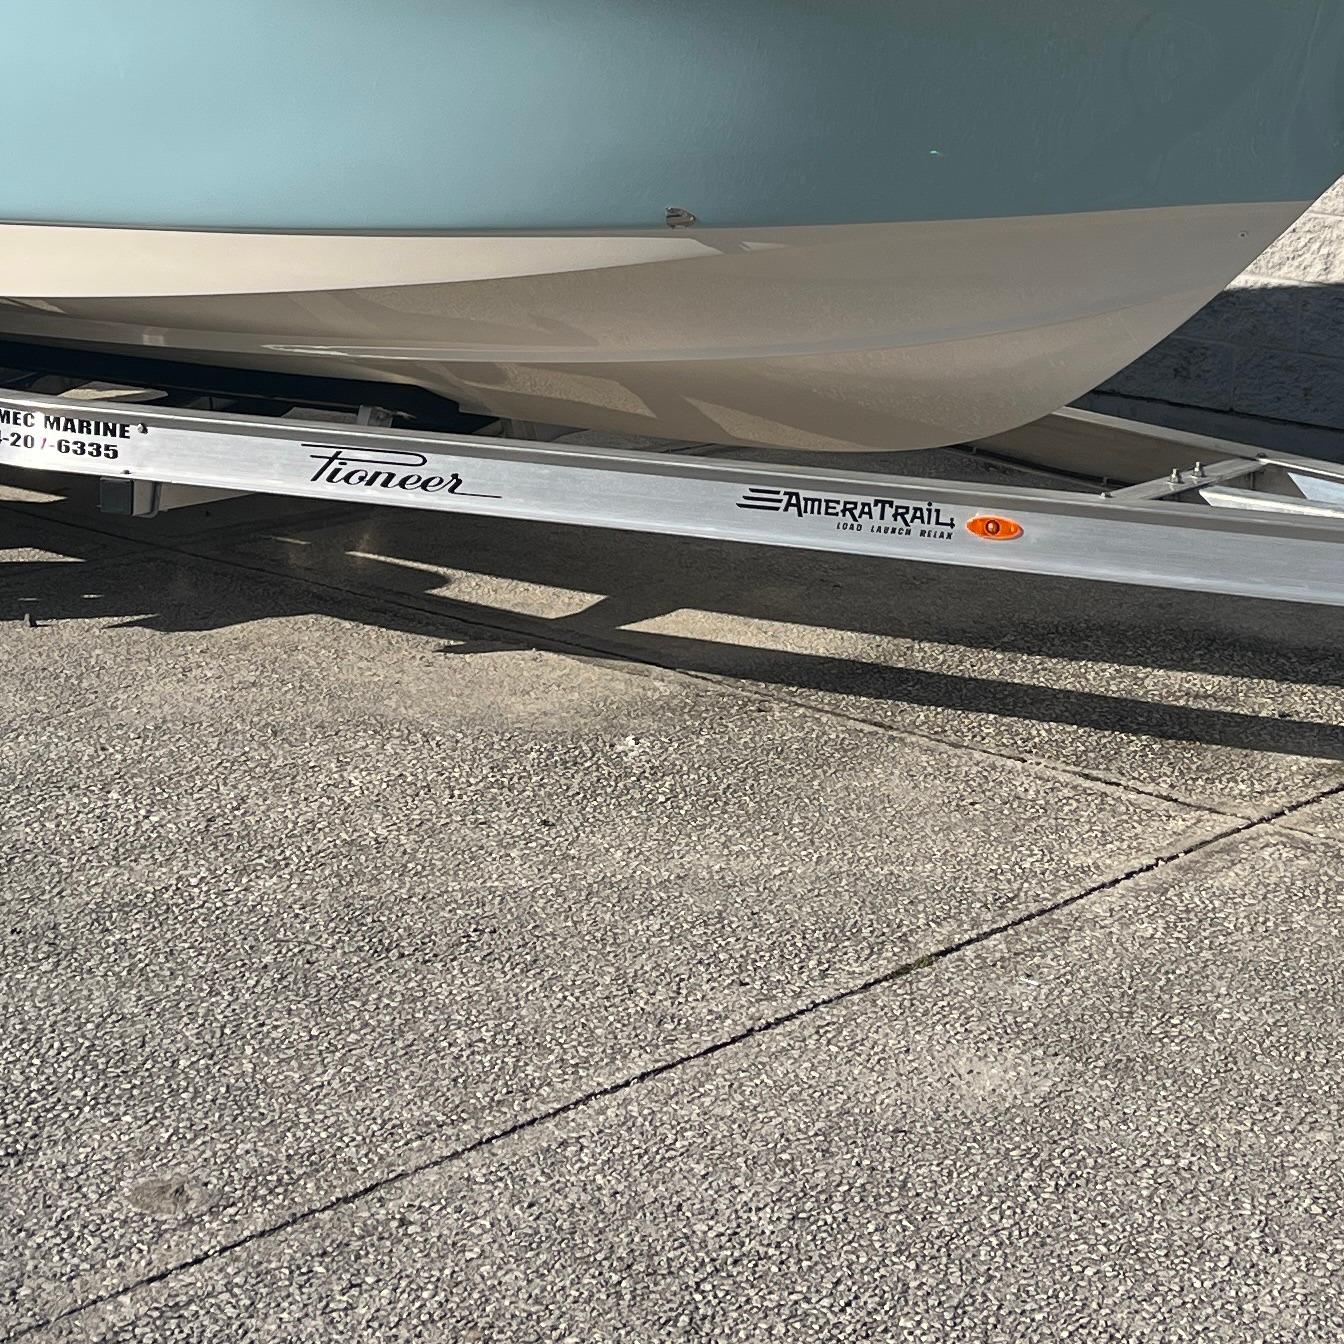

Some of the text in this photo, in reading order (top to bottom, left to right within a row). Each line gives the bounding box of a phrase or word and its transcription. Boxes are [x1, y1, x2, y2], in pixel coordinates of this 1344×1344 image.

[44, 415, 130, 439] MARINE
[302, 443, 501, 498] Pioneer
[836, 522, 953, 540] LOAD LAUNCH RELAX
